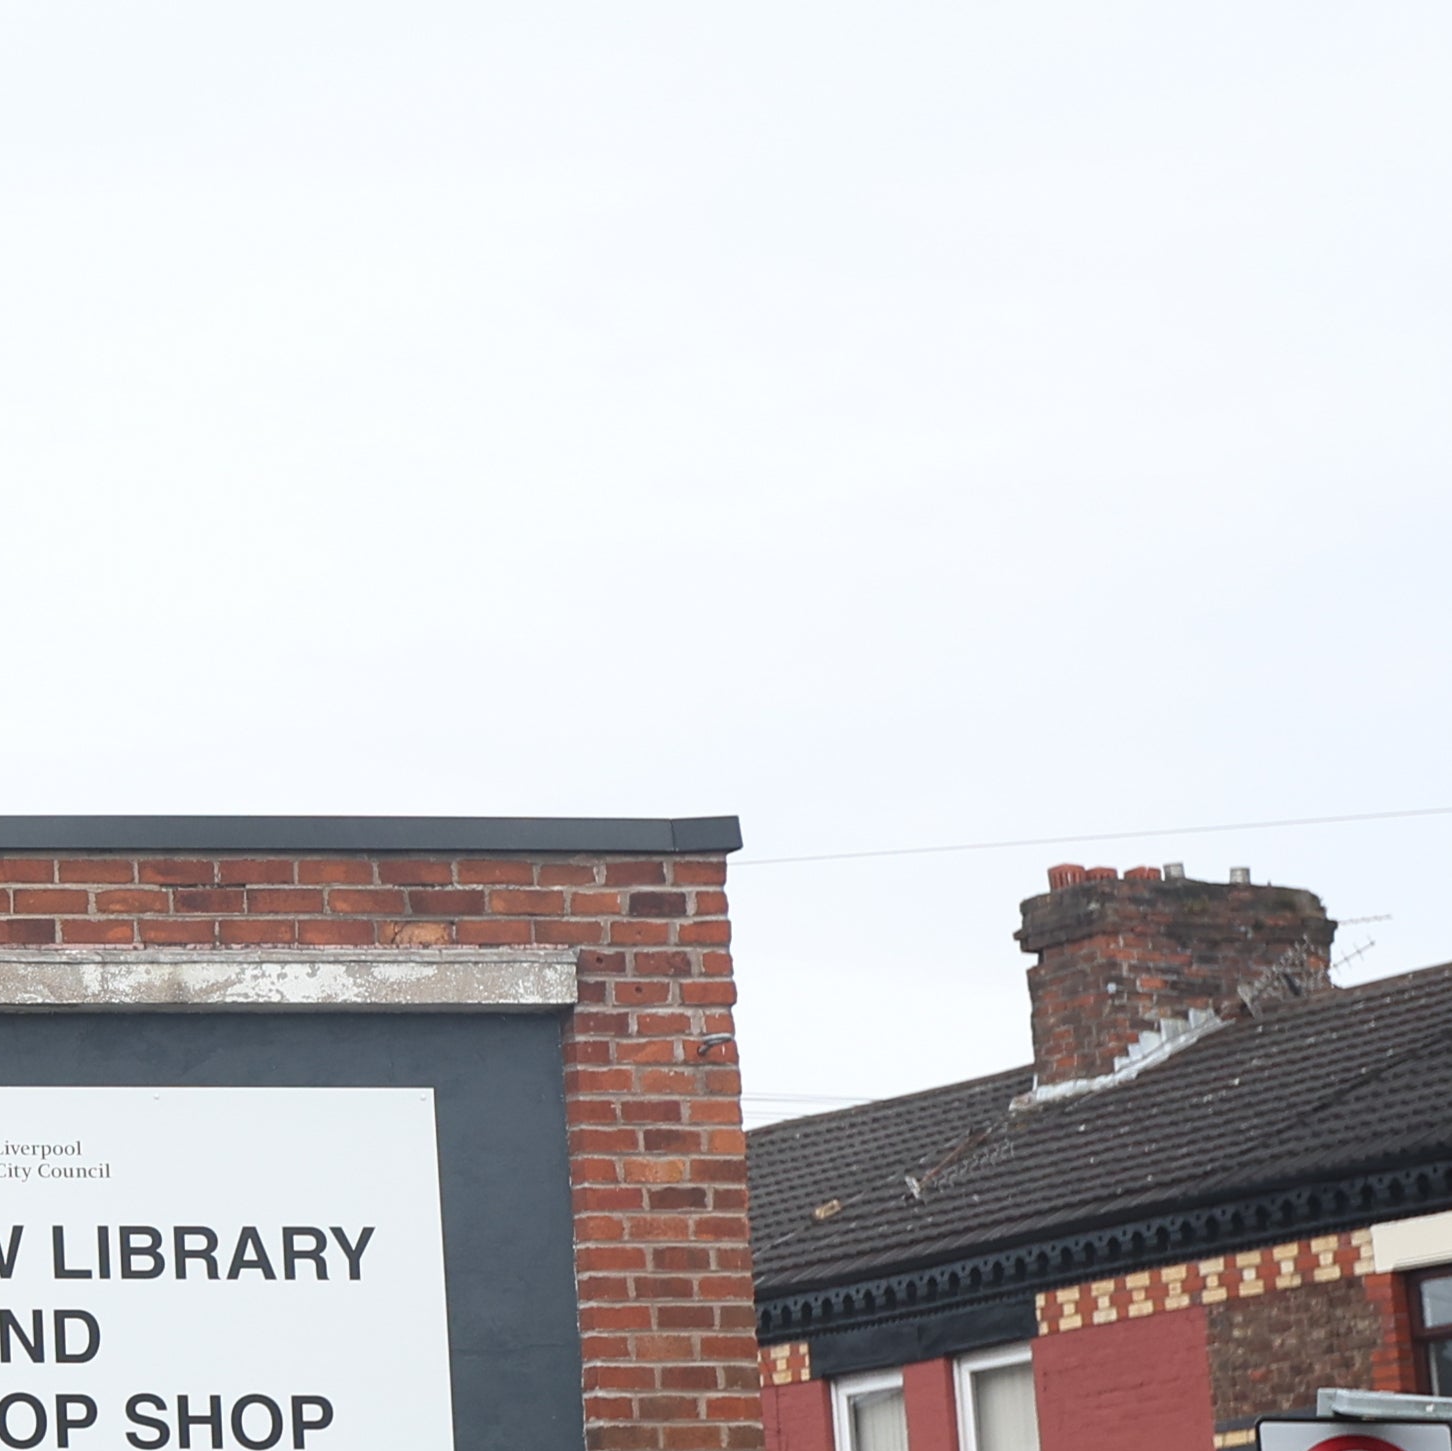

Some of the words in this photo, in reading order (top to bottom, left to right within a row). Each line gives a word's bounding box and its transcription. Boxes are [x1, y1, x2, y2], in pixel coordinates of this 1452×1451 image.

[37, 1162, 111, 1179] Council
[51, 1225, 376, 1281] LIBRARY
[124, 1393, 335, 1451] SHOP
